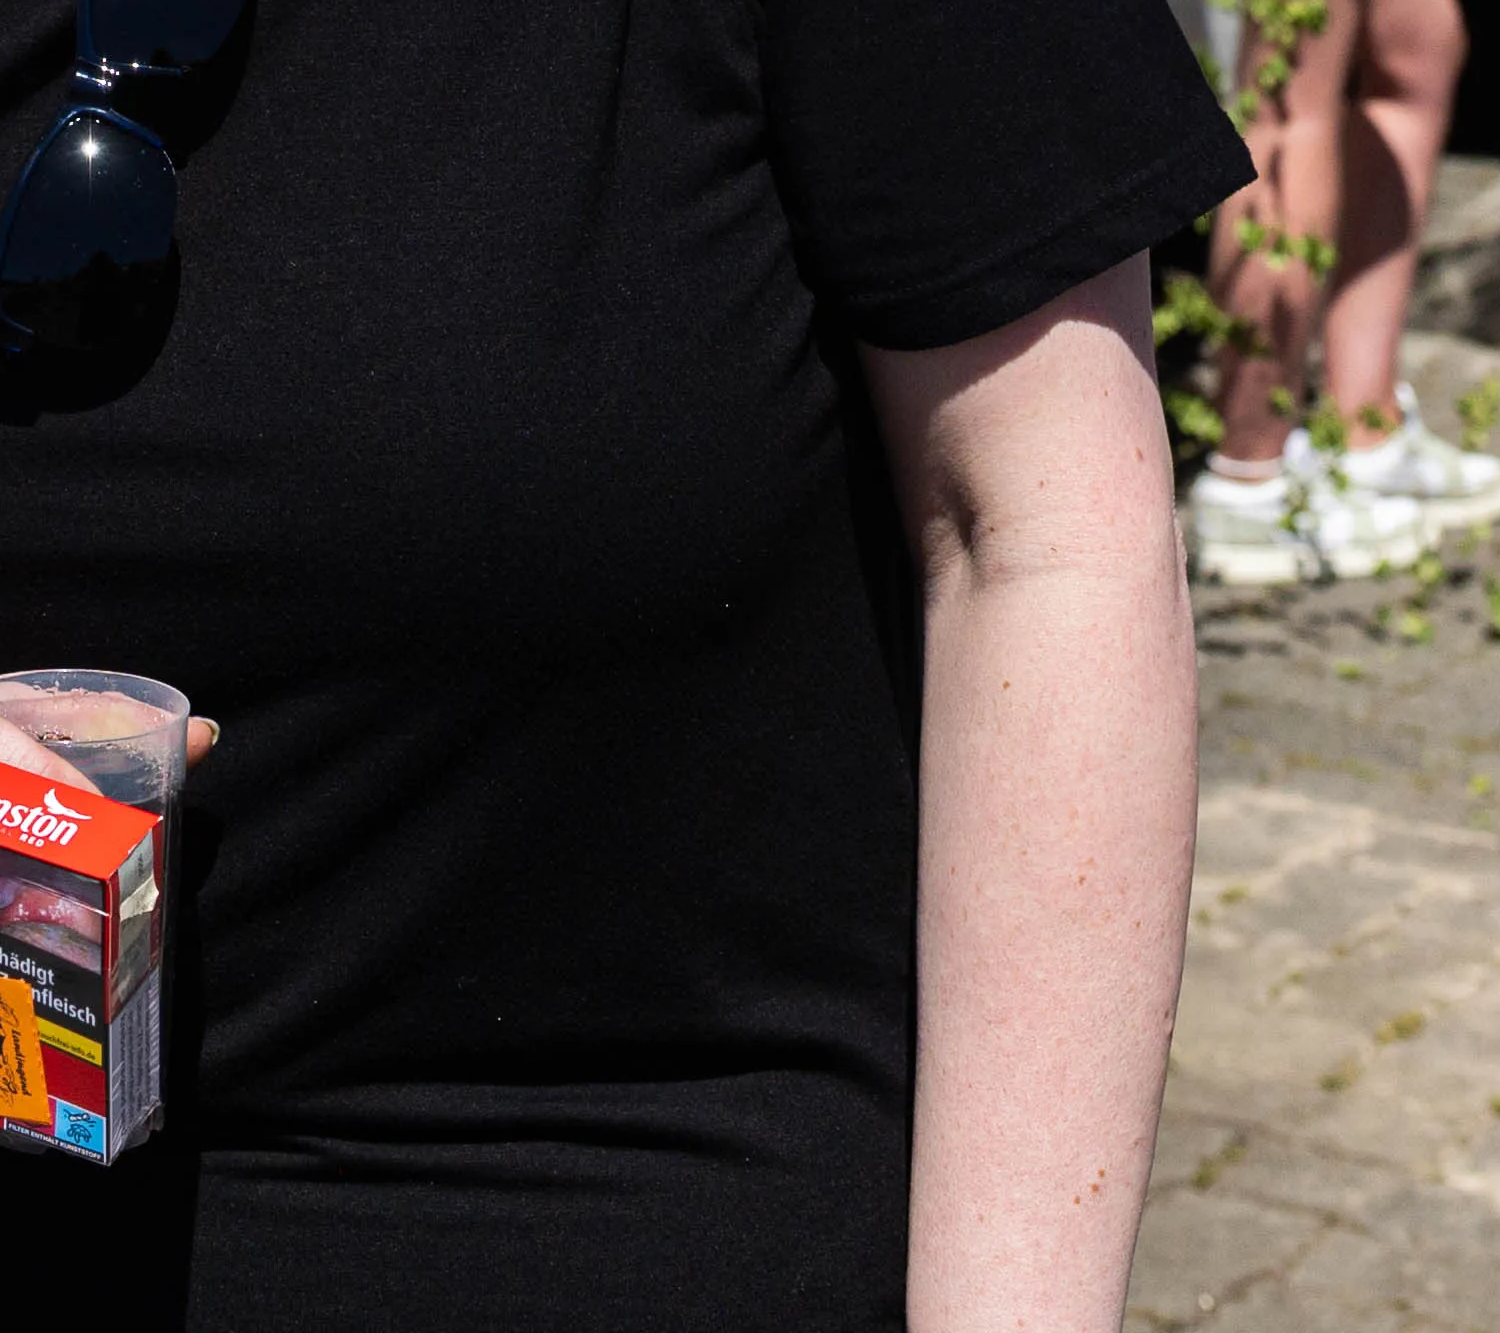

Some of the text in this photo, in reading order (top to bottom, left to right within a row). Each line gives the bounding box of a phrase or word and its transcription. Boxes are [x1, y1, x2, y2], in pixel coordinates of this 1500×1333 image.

[18, 832, 45, 848] RED
[8, 1122, 30, 1137] FILTER
[60, 1141, 102, 1160] KUNSTSTOFF
